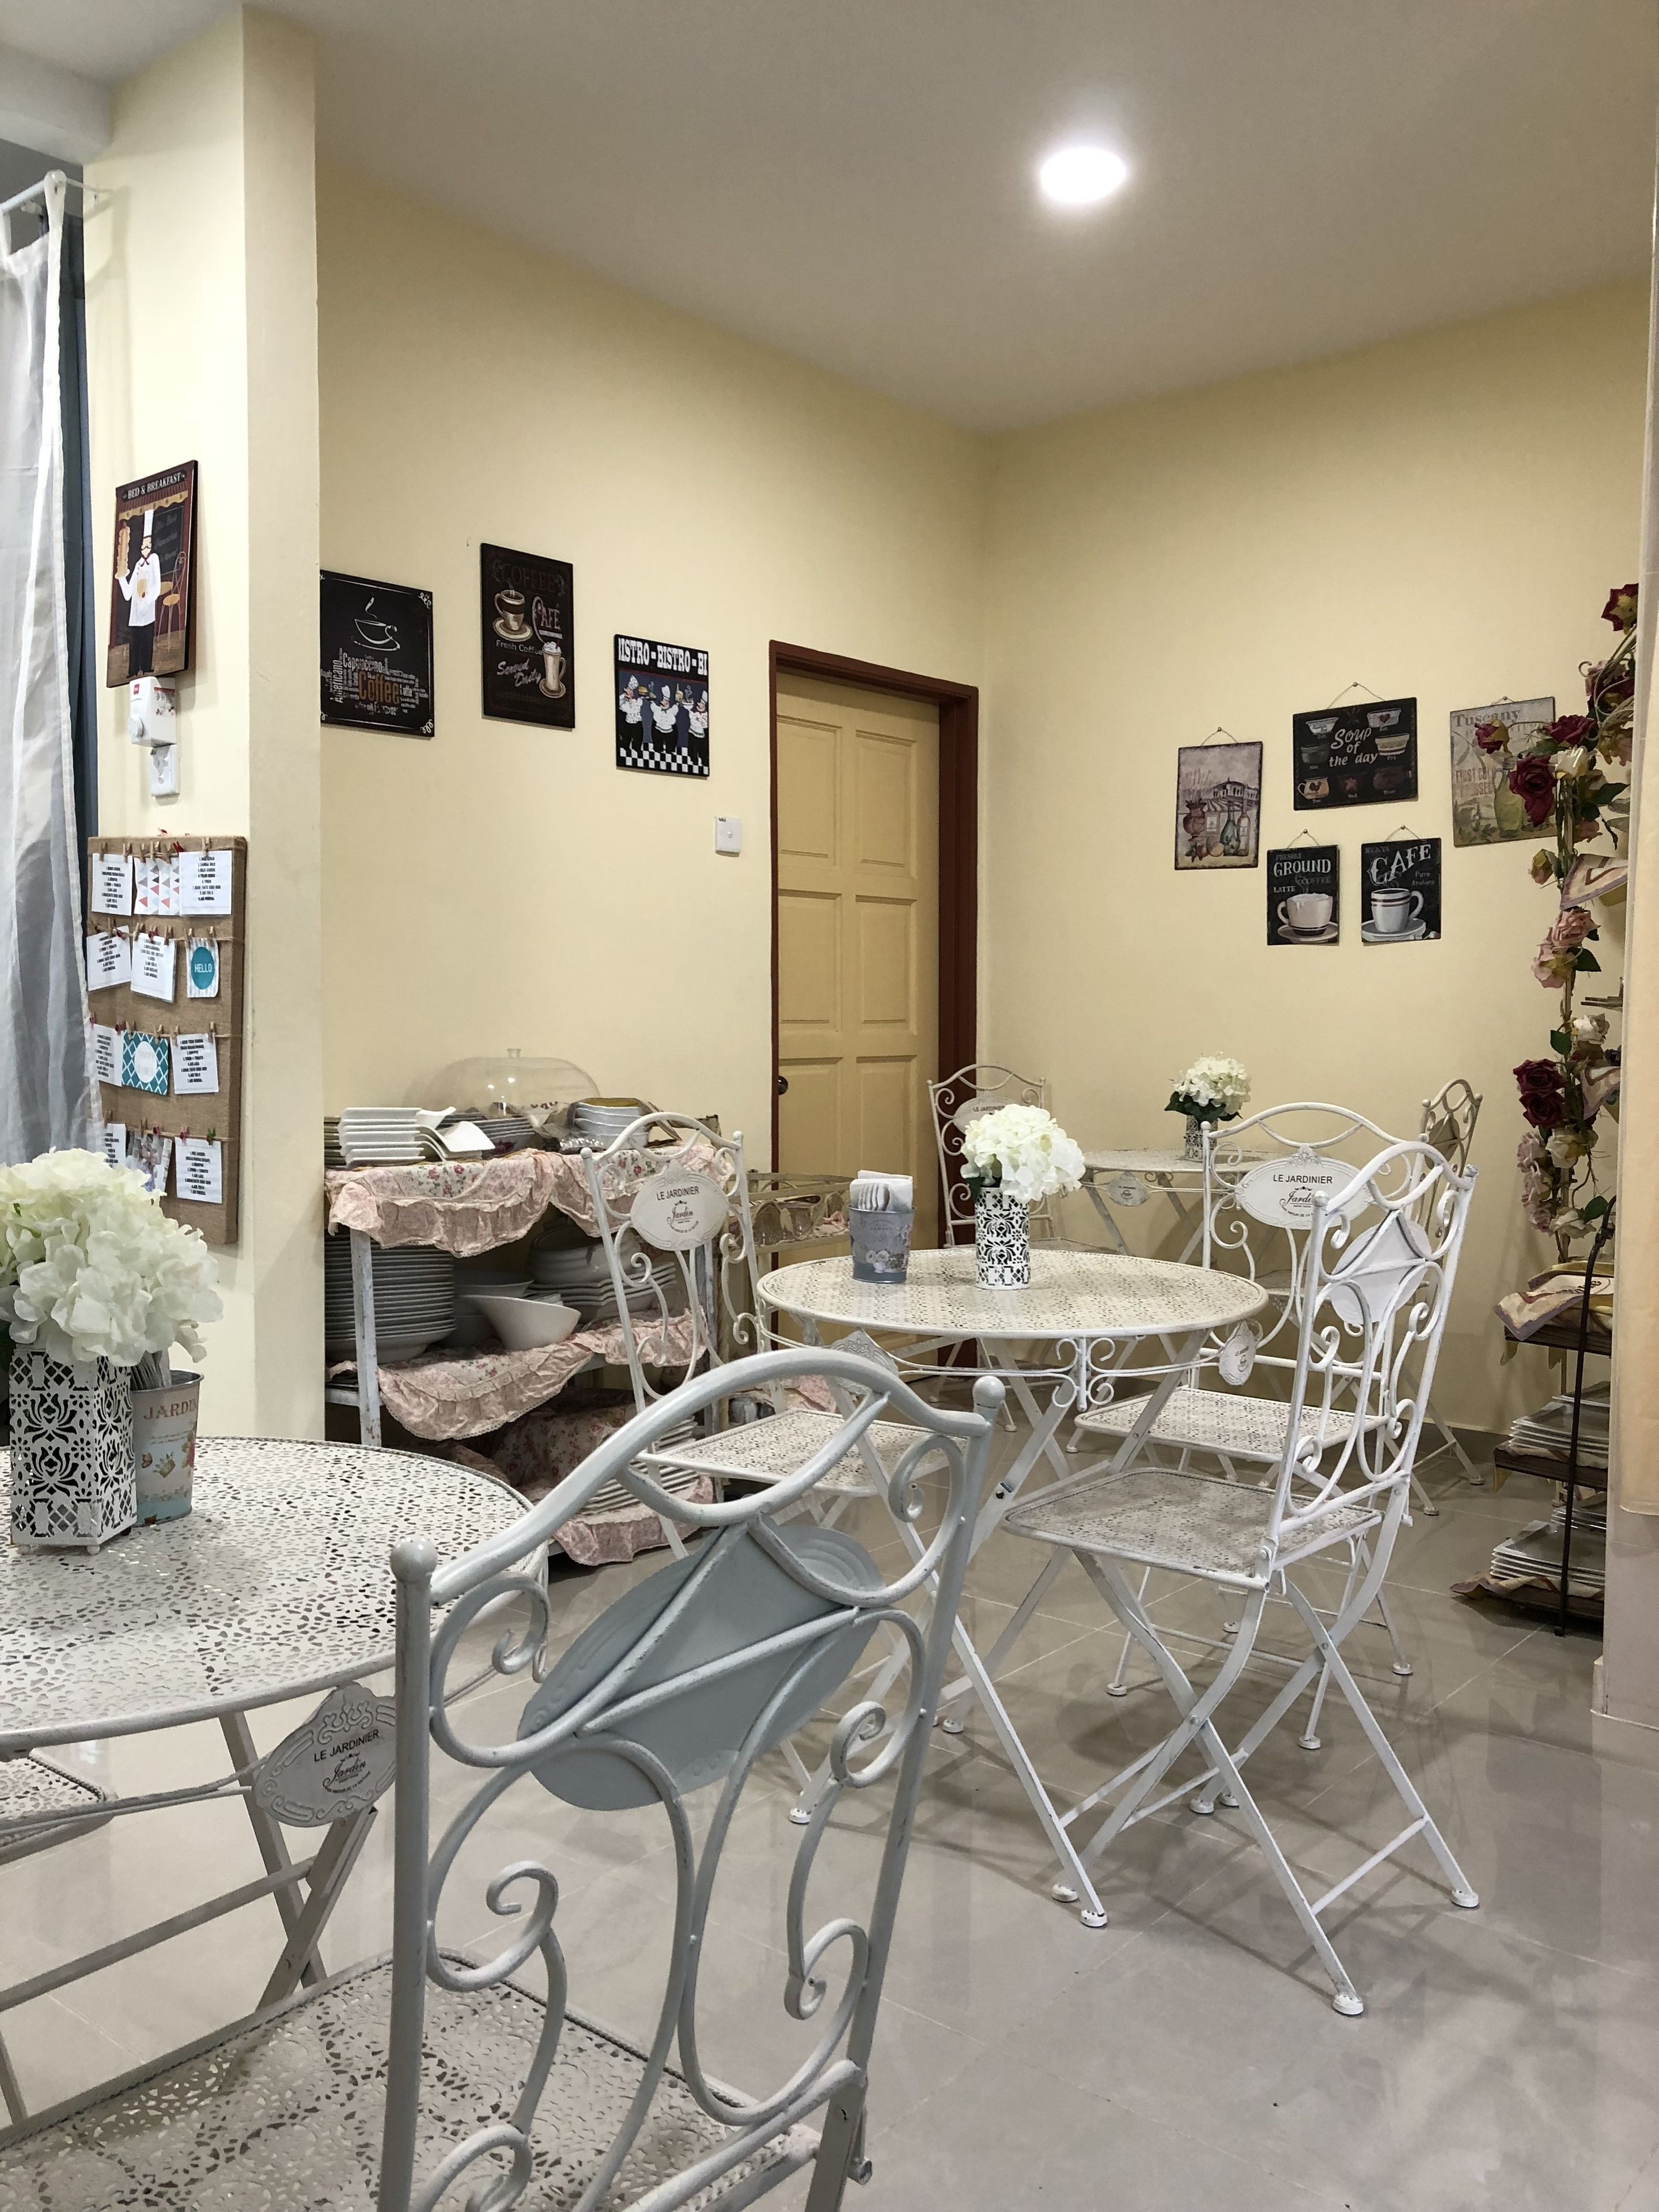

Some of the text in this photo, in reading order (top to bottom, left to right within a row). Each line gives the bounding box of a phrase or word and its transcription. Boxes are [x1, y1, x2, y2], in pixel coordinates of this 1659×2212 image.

[128, 472, 181, 499] BED & BREAKFAST
[496, 639, 517, 650] Fresh
[343, 652, 382, 673] Cappuccino
[618, 638, 650, 665] ISTRO
[657, 645, 691, 673] BISTRO
[358, 671, 400, 704] Coffee
[1346, 741, 1360, 755] of
[1329, 752, 1378, 767] the day
[1273, 859, 1331, 877] GROUND
[1367, 844, 1431, 885] CAFE
[1273, 885, 1296, 893] LATTE
[194, 963, 213, 973] HELLO
[1273, 1174, 1332, 1184] LE JARDINIER
[656, 1186, 700, 1201] LE JARDINIER
[314, 1728, 380, 1763] LE JARDINIER
[323, 1758, 366, 1787] Jardin
